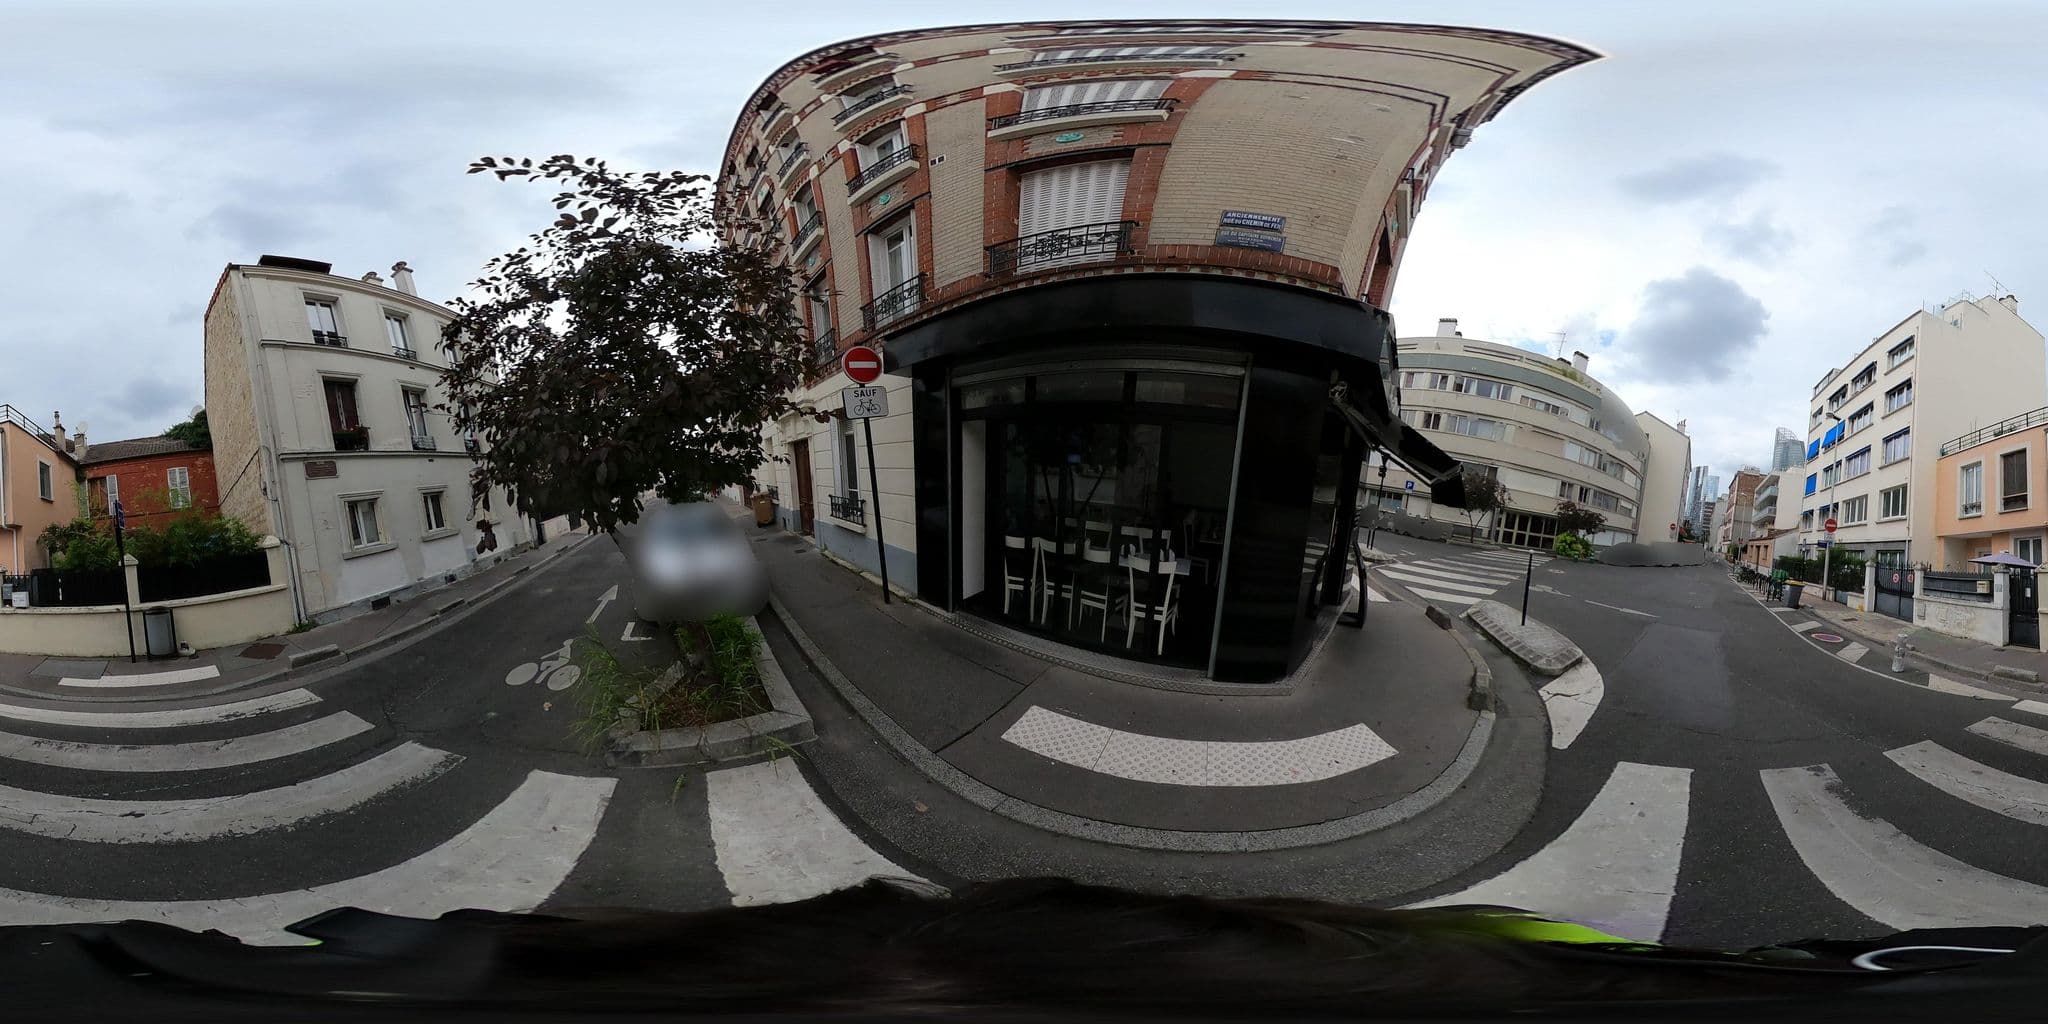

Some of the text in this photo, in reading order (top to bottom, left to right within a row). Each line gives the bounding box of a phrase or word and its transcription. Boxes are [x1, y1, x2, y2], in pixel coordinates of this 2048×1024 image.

[1226, 212, 1281, 223] ANCIENNEMENT
[1241, 219, 1264, 227] CHEMIN
[854, 389, 877, 398] SAUF
